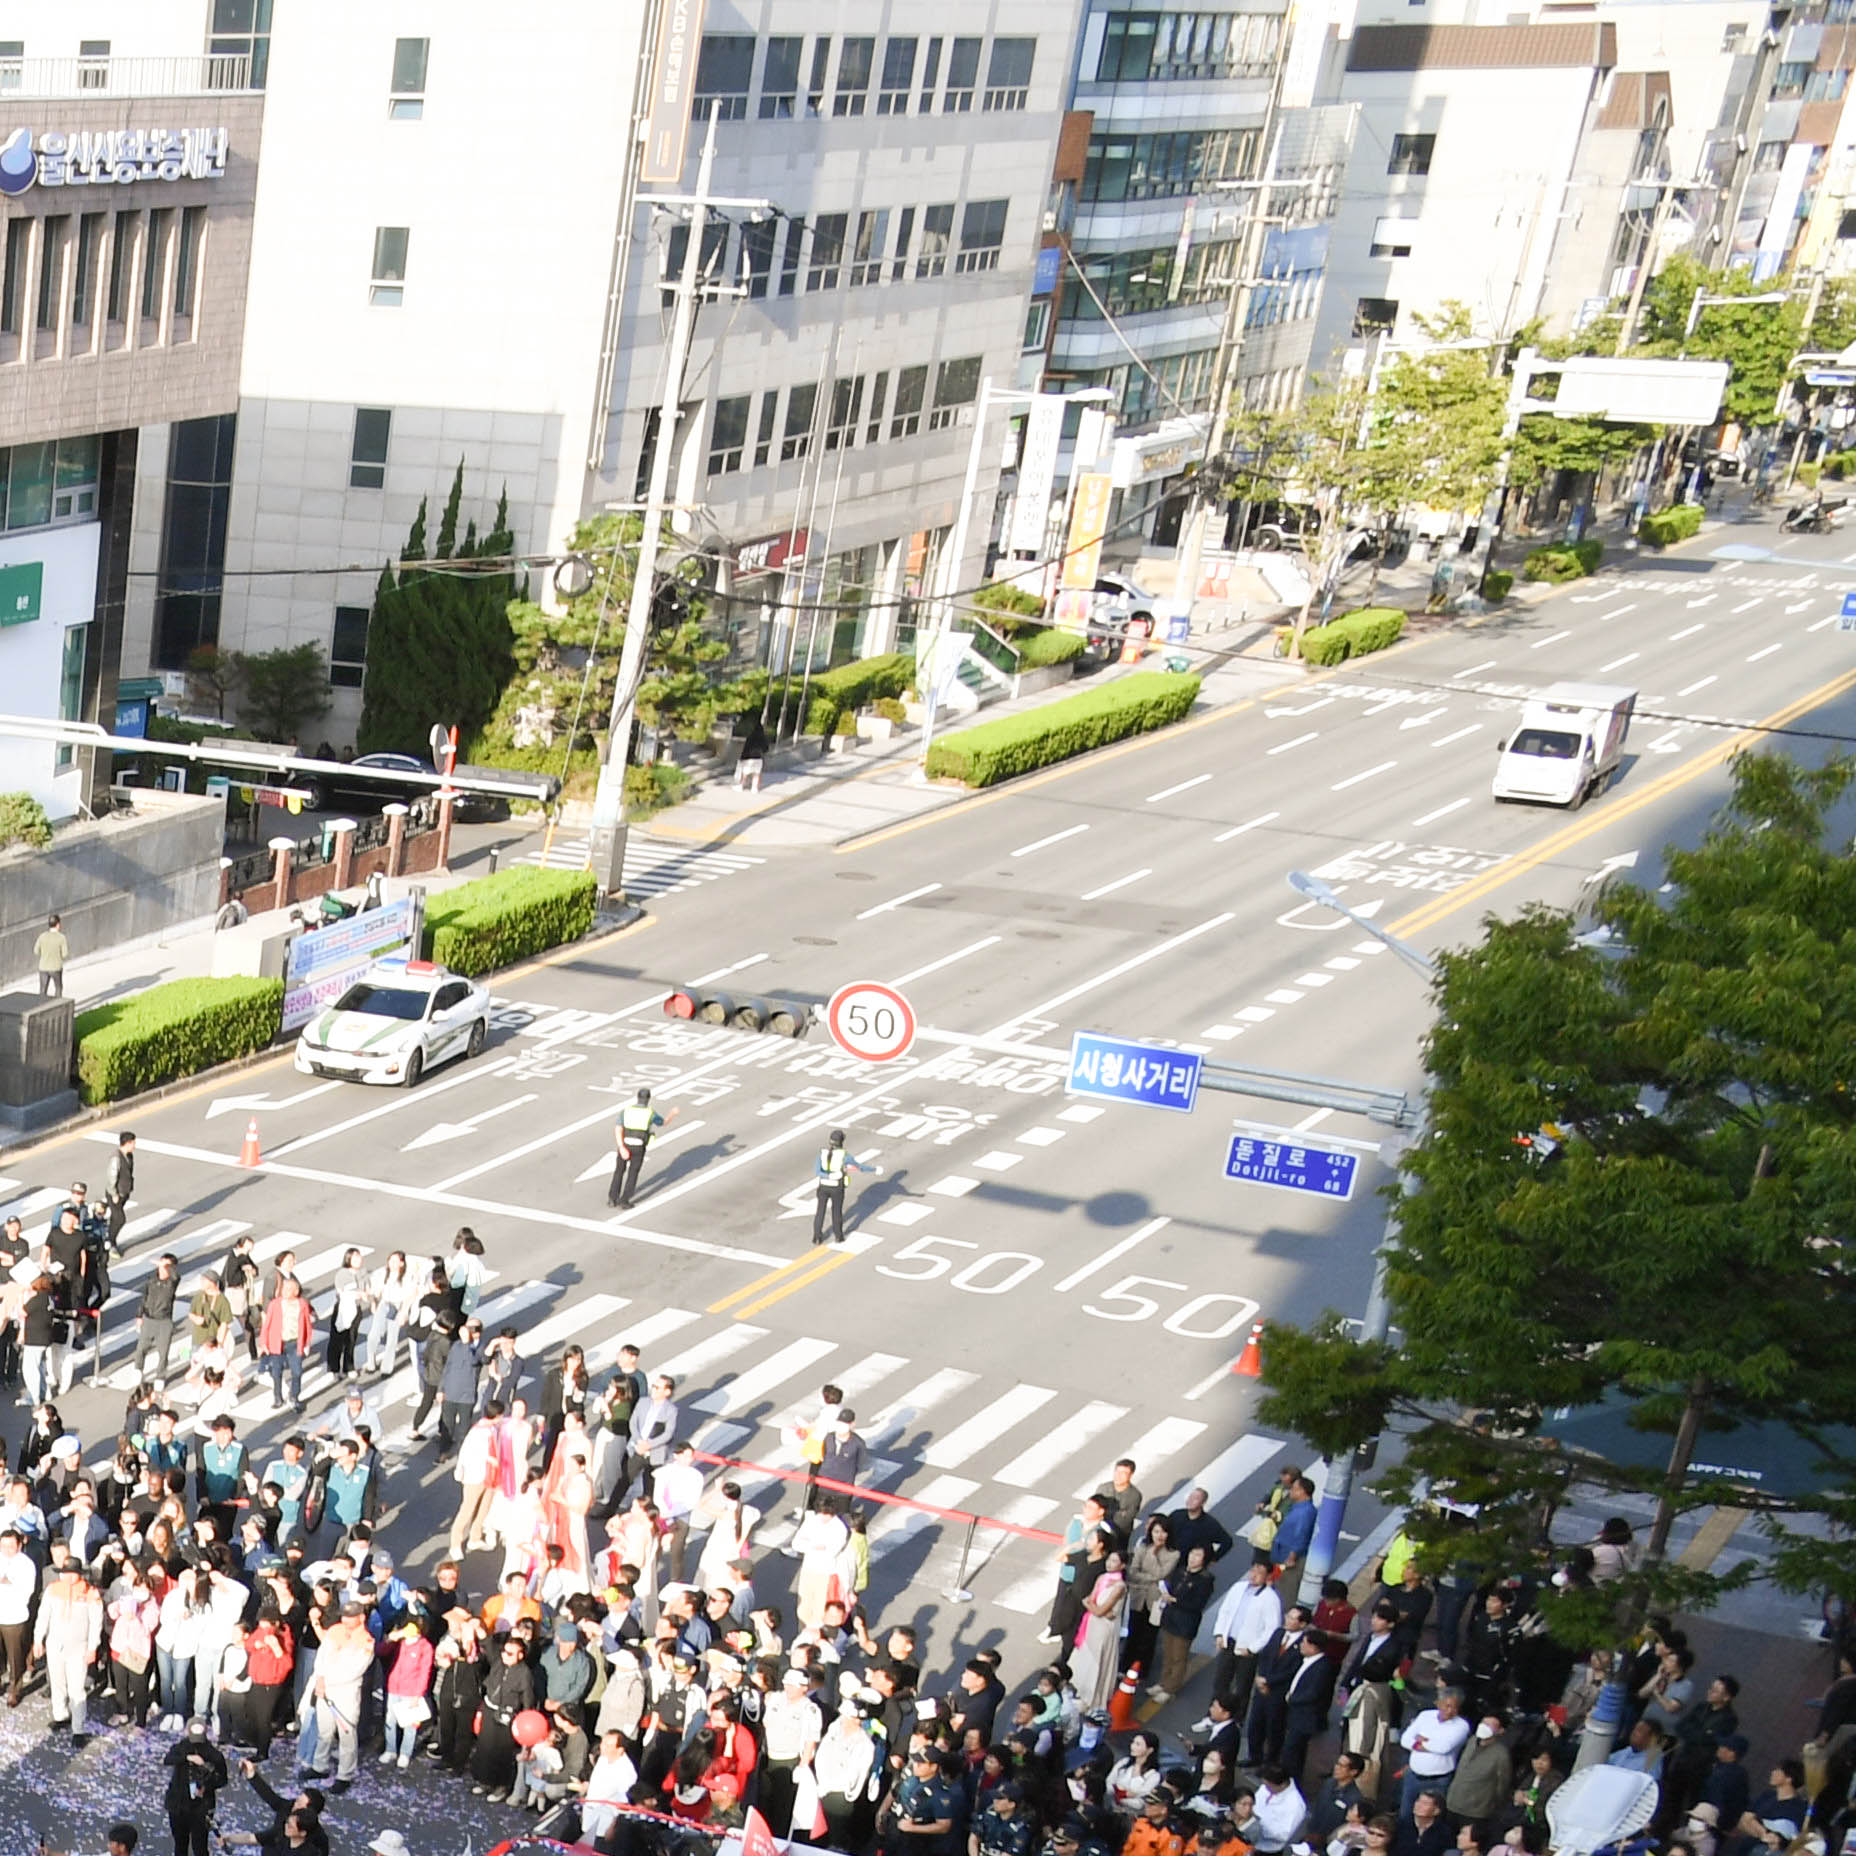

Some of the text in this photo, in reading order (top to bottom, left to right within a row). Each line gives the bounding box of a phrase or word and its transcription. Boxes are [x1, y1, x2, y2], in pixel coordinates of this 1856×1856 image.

[39, 126, 228, 189] 울산신용보증재단
[847, 1003, 897, 1042] 50
[1074, 1046, 1198, 1104] 시청사거리
[1235, 1138, 1308, 1170] 돋질로
[1326, 1154, 1352, 1169] 452
[1230, 1161, 1308, 1187] Dotjil-ro
[1324, 1179, 1341, 1194] 68
[875, 1233, 1045, 1295] 50
[1081, 1274, 1261, 1340] 50
